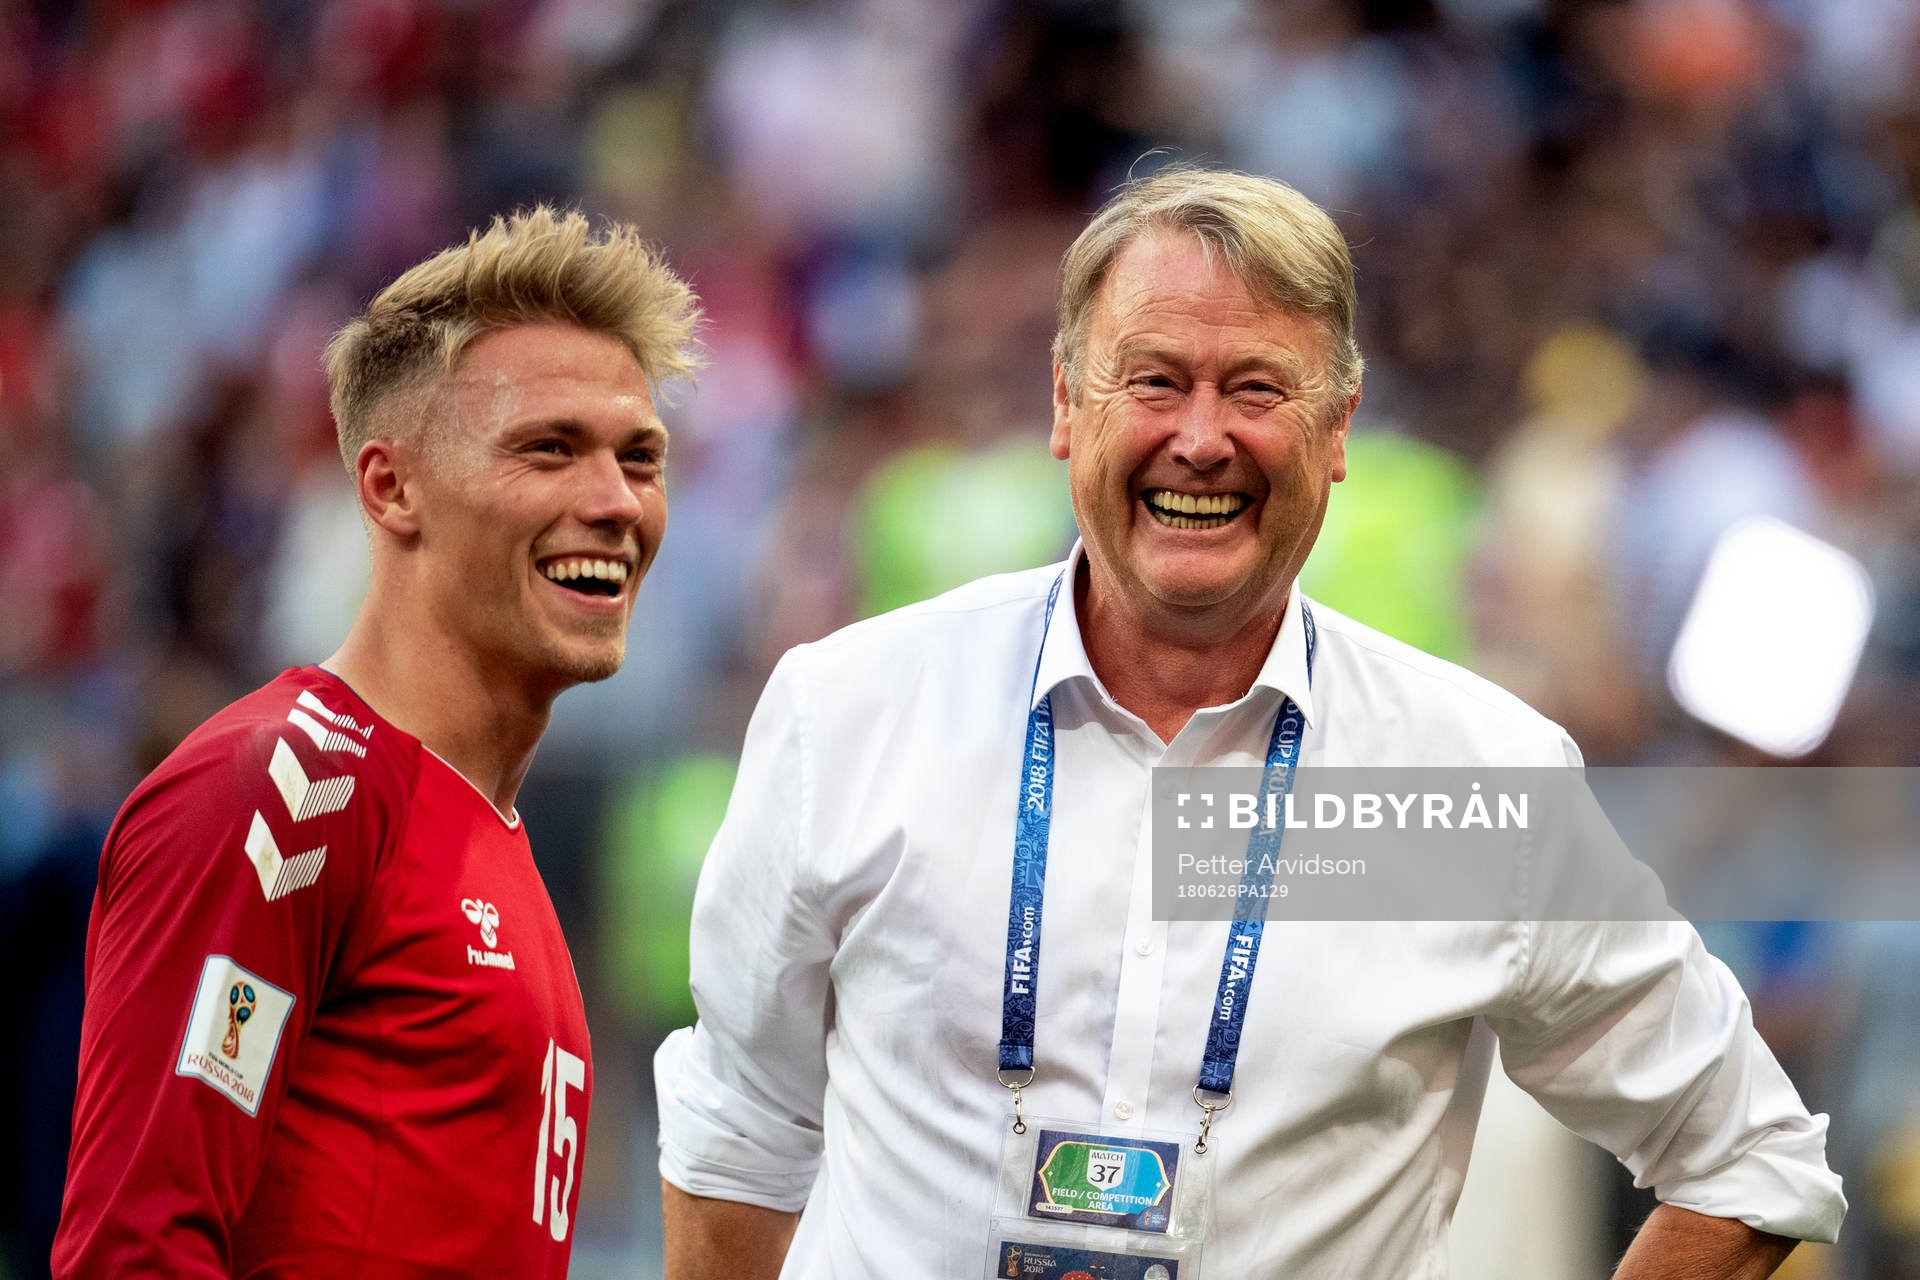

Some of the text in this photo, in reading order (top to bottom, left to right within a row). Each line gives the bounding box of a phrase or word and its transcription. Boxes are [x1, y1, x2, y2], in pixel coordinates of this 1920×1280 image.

[1031, 721, 1050, 763] FIFA
[1276, 717, 1299, 759] CUP
[1027, 765, 1048, 811] 2018
[466, 944, 516, 971] hummel
[187, 1054, 255, 1102] RUSSIA 2018
[532, 1037, 585, 1242] 15
[1091, 1151, 1123, 1161] MATCH
[1090, 1164, 1121, 1184] 37
[1051, 1187, 1078, 1198] FIELD
[1086, 1191, 1153, 1205] COMPETITION
[1087, 1201, 1114, 1211] AREA
[1024, 1257, 1057, 1267] RUSSIA
[1024, 1265, 1044, 1273] 2018
